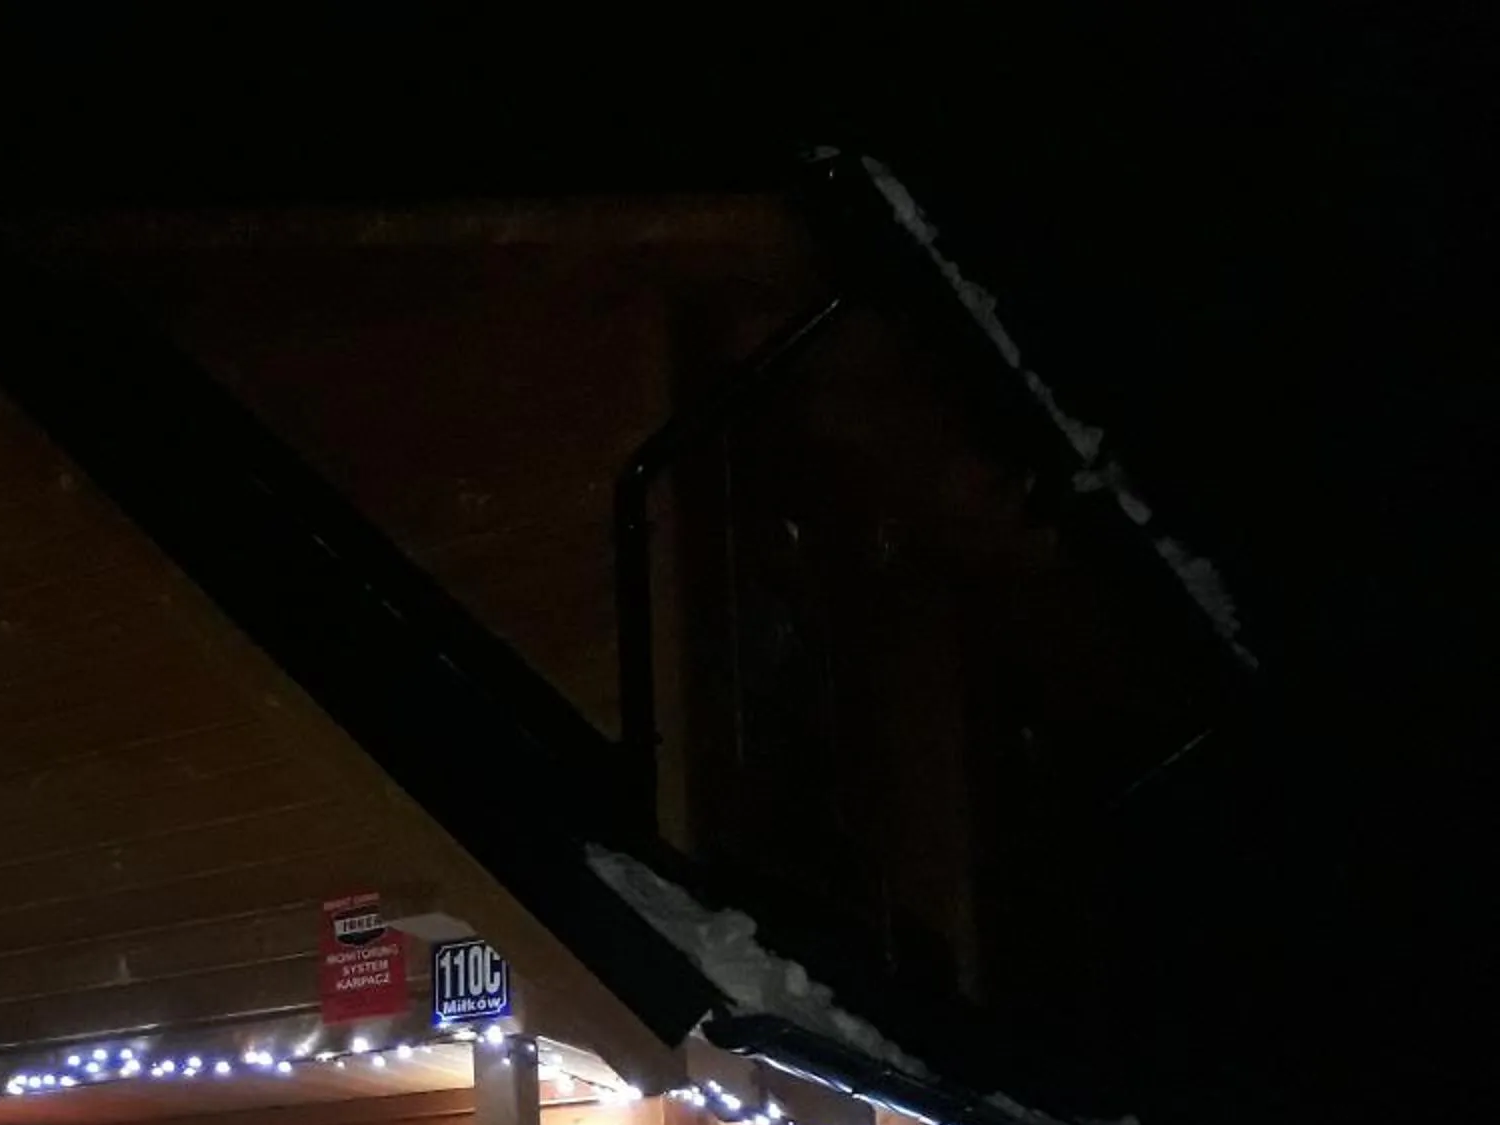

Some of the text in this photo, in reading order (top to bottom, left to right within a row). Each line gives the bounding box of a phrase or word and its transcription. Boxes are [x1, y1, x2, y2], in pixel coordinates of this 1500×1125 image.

[343, 960, 389, 976] SYSTEM
[440, 945, 501, 999] 110C
[336, 973, 391, 990] KARPACZ
